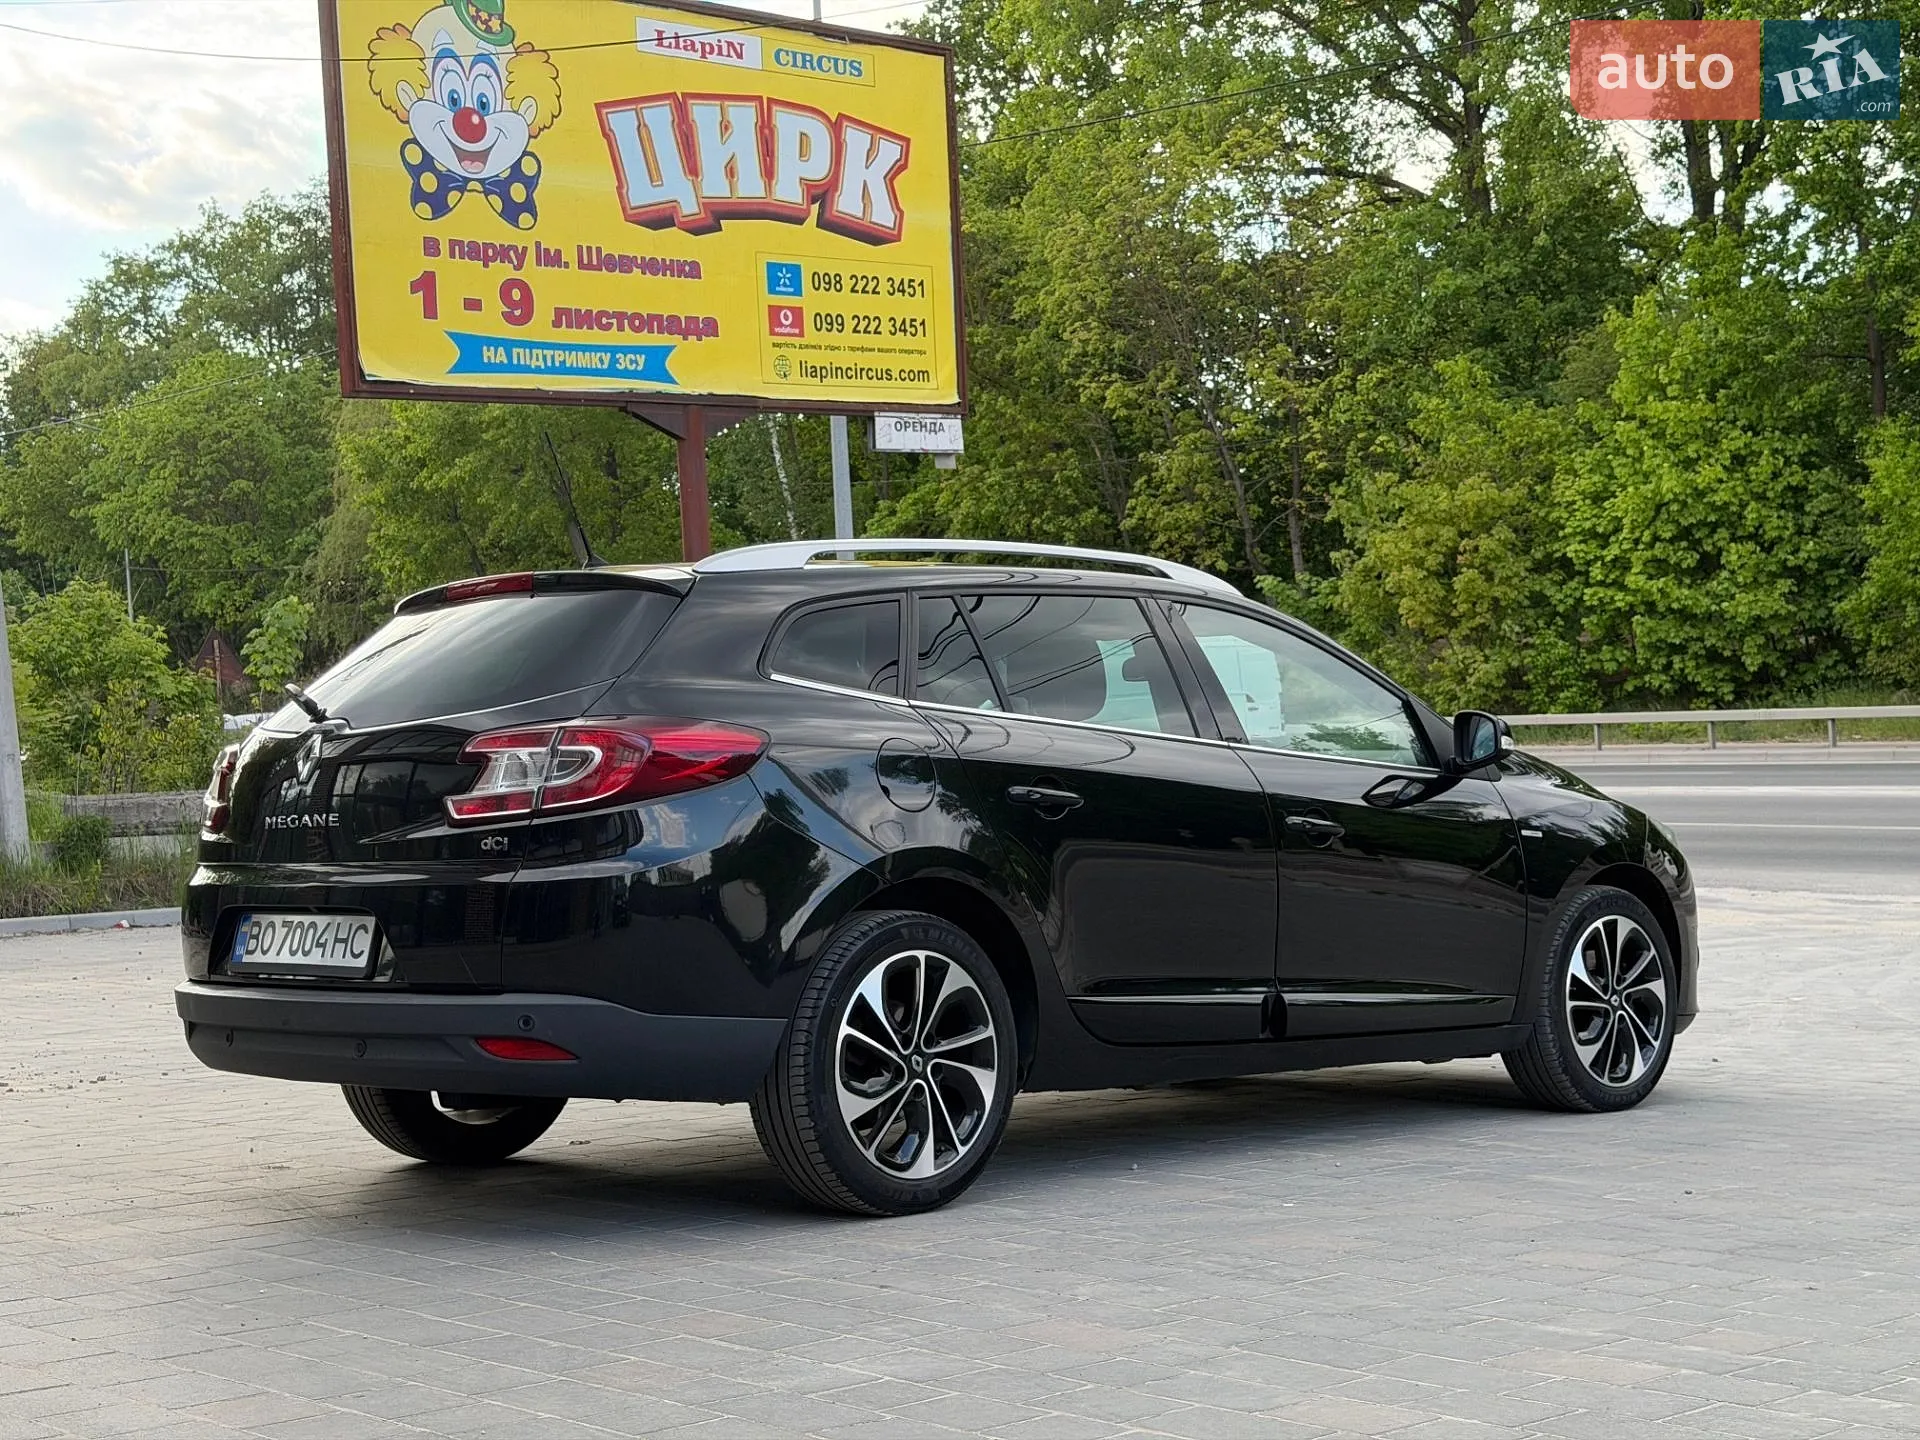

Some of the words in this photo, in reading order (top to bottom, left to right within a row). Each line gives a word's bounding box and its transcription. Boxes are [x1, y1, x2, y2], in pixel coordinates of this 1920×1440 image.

[653, 28, 745, 60] LiapiN
[774, 48, 863, 78] CIRCUS
[597, 94, 910, 240] ЦИРК
[448, 238, 529, 271] парку
[576, 244, 702, 280] Шевченка
[811, 271, 843, 293] 098
[849, 274, 881, 296] 222
[886, 277, 925, 299] 3451
[409, 270, 439, 320] 1
[463, 297, 483, 312] -
[498, 277, 535, 326] 9
[551, 305, 720, 342] листопада
[813, 311, 845, 334] 099
[851, 314, 882, 336] 222
[888, 316, 927, 338] 3451
[482, 346, 508, 364] НА
[512, 347, 611, 369] ПІДТРИМКУ
[615, 352, 646, 371] ЗСУ
[799, 360, 930, 383] liapincircus.com
[893, 420, 946, 435] ОРЕНДА
[264, 813, 340, 830] MEGANE
